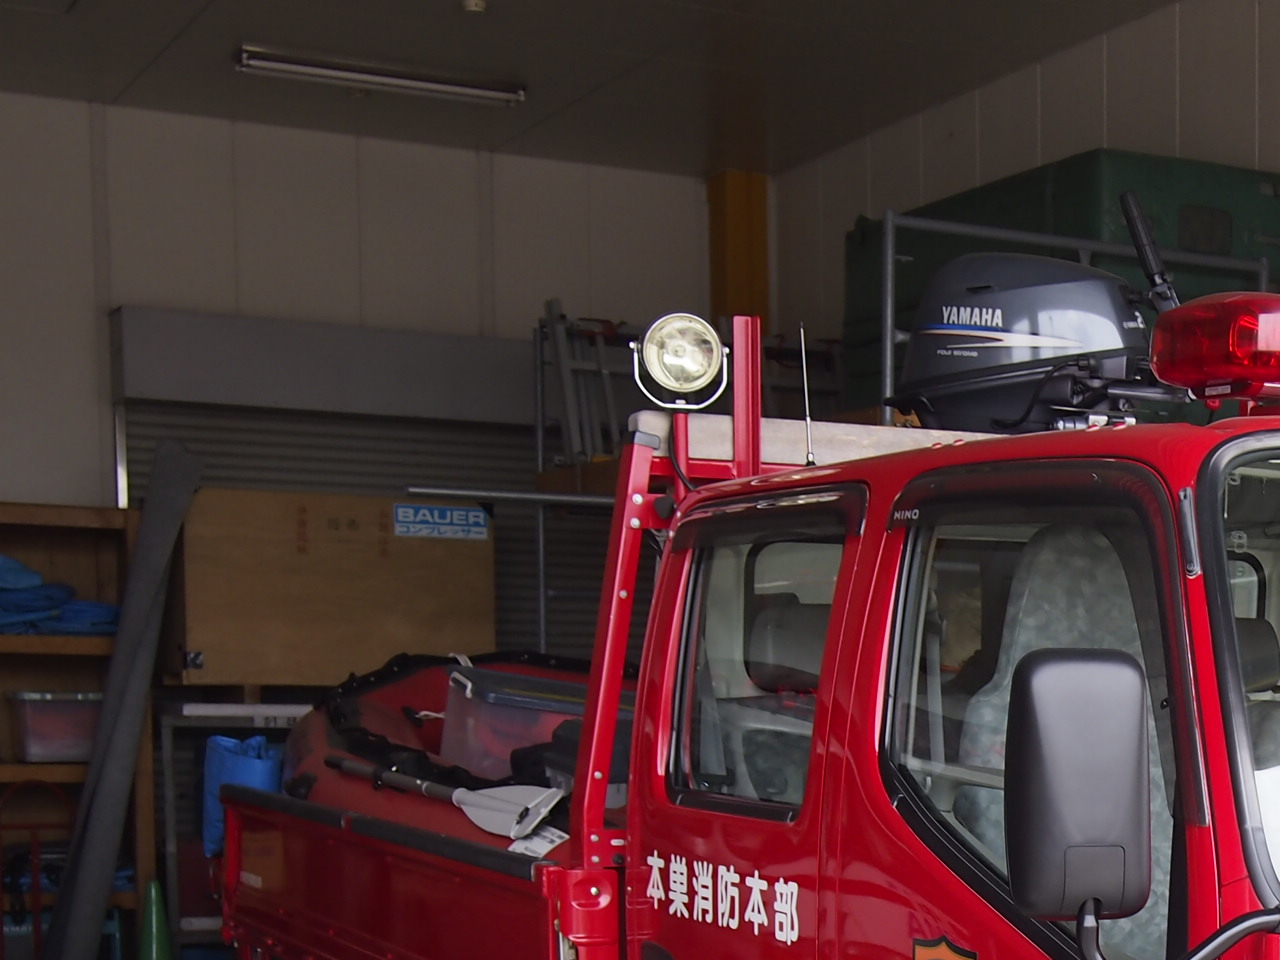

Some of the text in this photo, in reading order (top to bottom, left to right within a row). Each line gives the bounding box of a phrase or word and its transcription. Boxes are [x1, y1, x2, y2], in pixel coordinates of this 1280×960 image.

[942, 306, 1003, 327] YAMAHA
[397, 507, 486, 525] BAUER
[893, 509, 920, 520] HINO
[646, 849, 799, 946] 本巣消防本部
